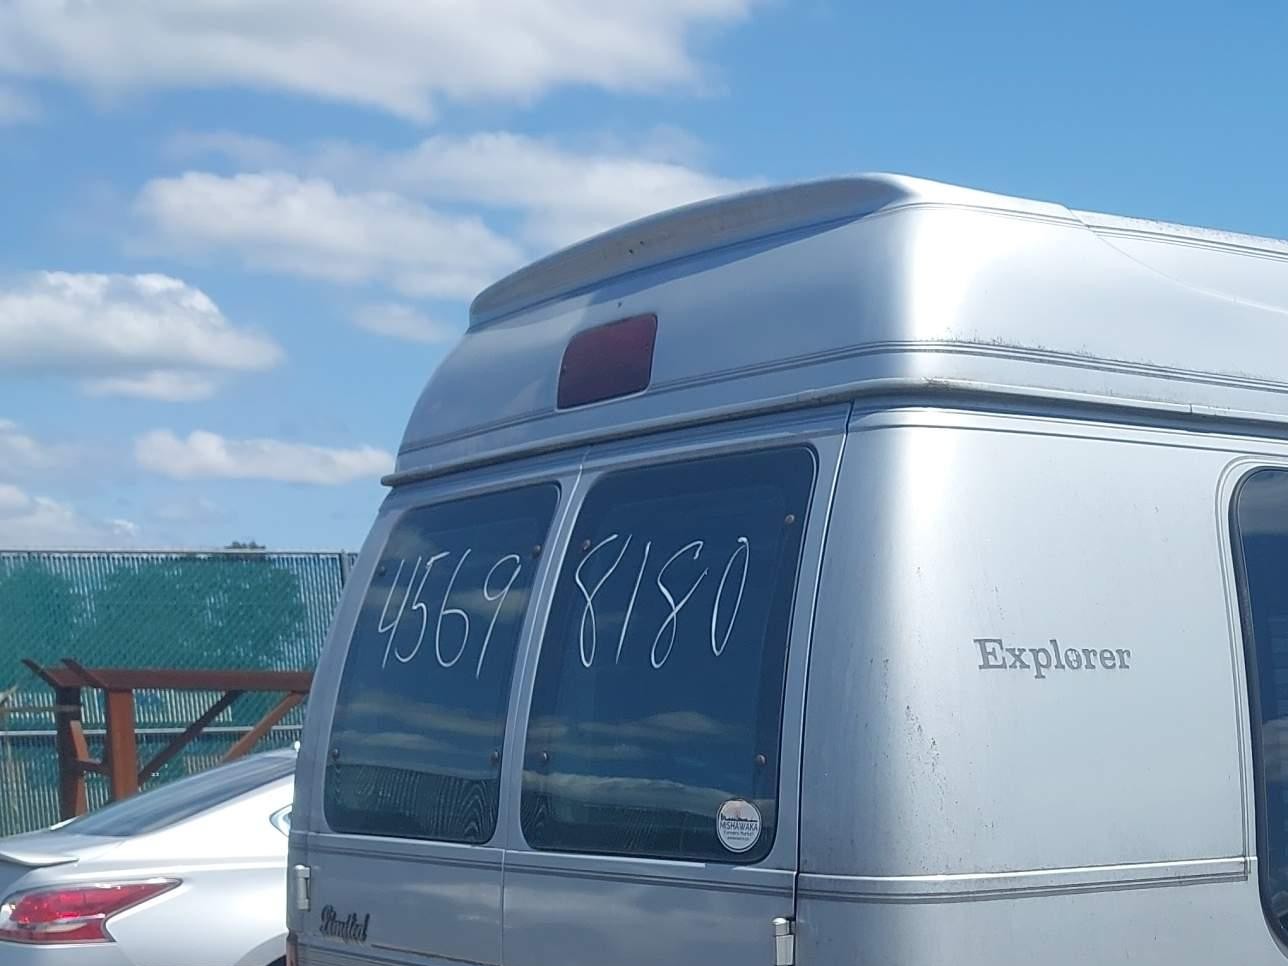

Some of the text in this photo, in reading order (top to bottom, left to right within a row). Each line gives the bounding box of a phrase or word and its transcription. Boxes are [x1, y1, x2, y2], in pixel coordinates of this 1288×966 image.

[378, 533, 750, 679] 4569 8180
[973, 638, 1131, 679] Explorer
[720, 821, 758, 831] MISHAWAKA
